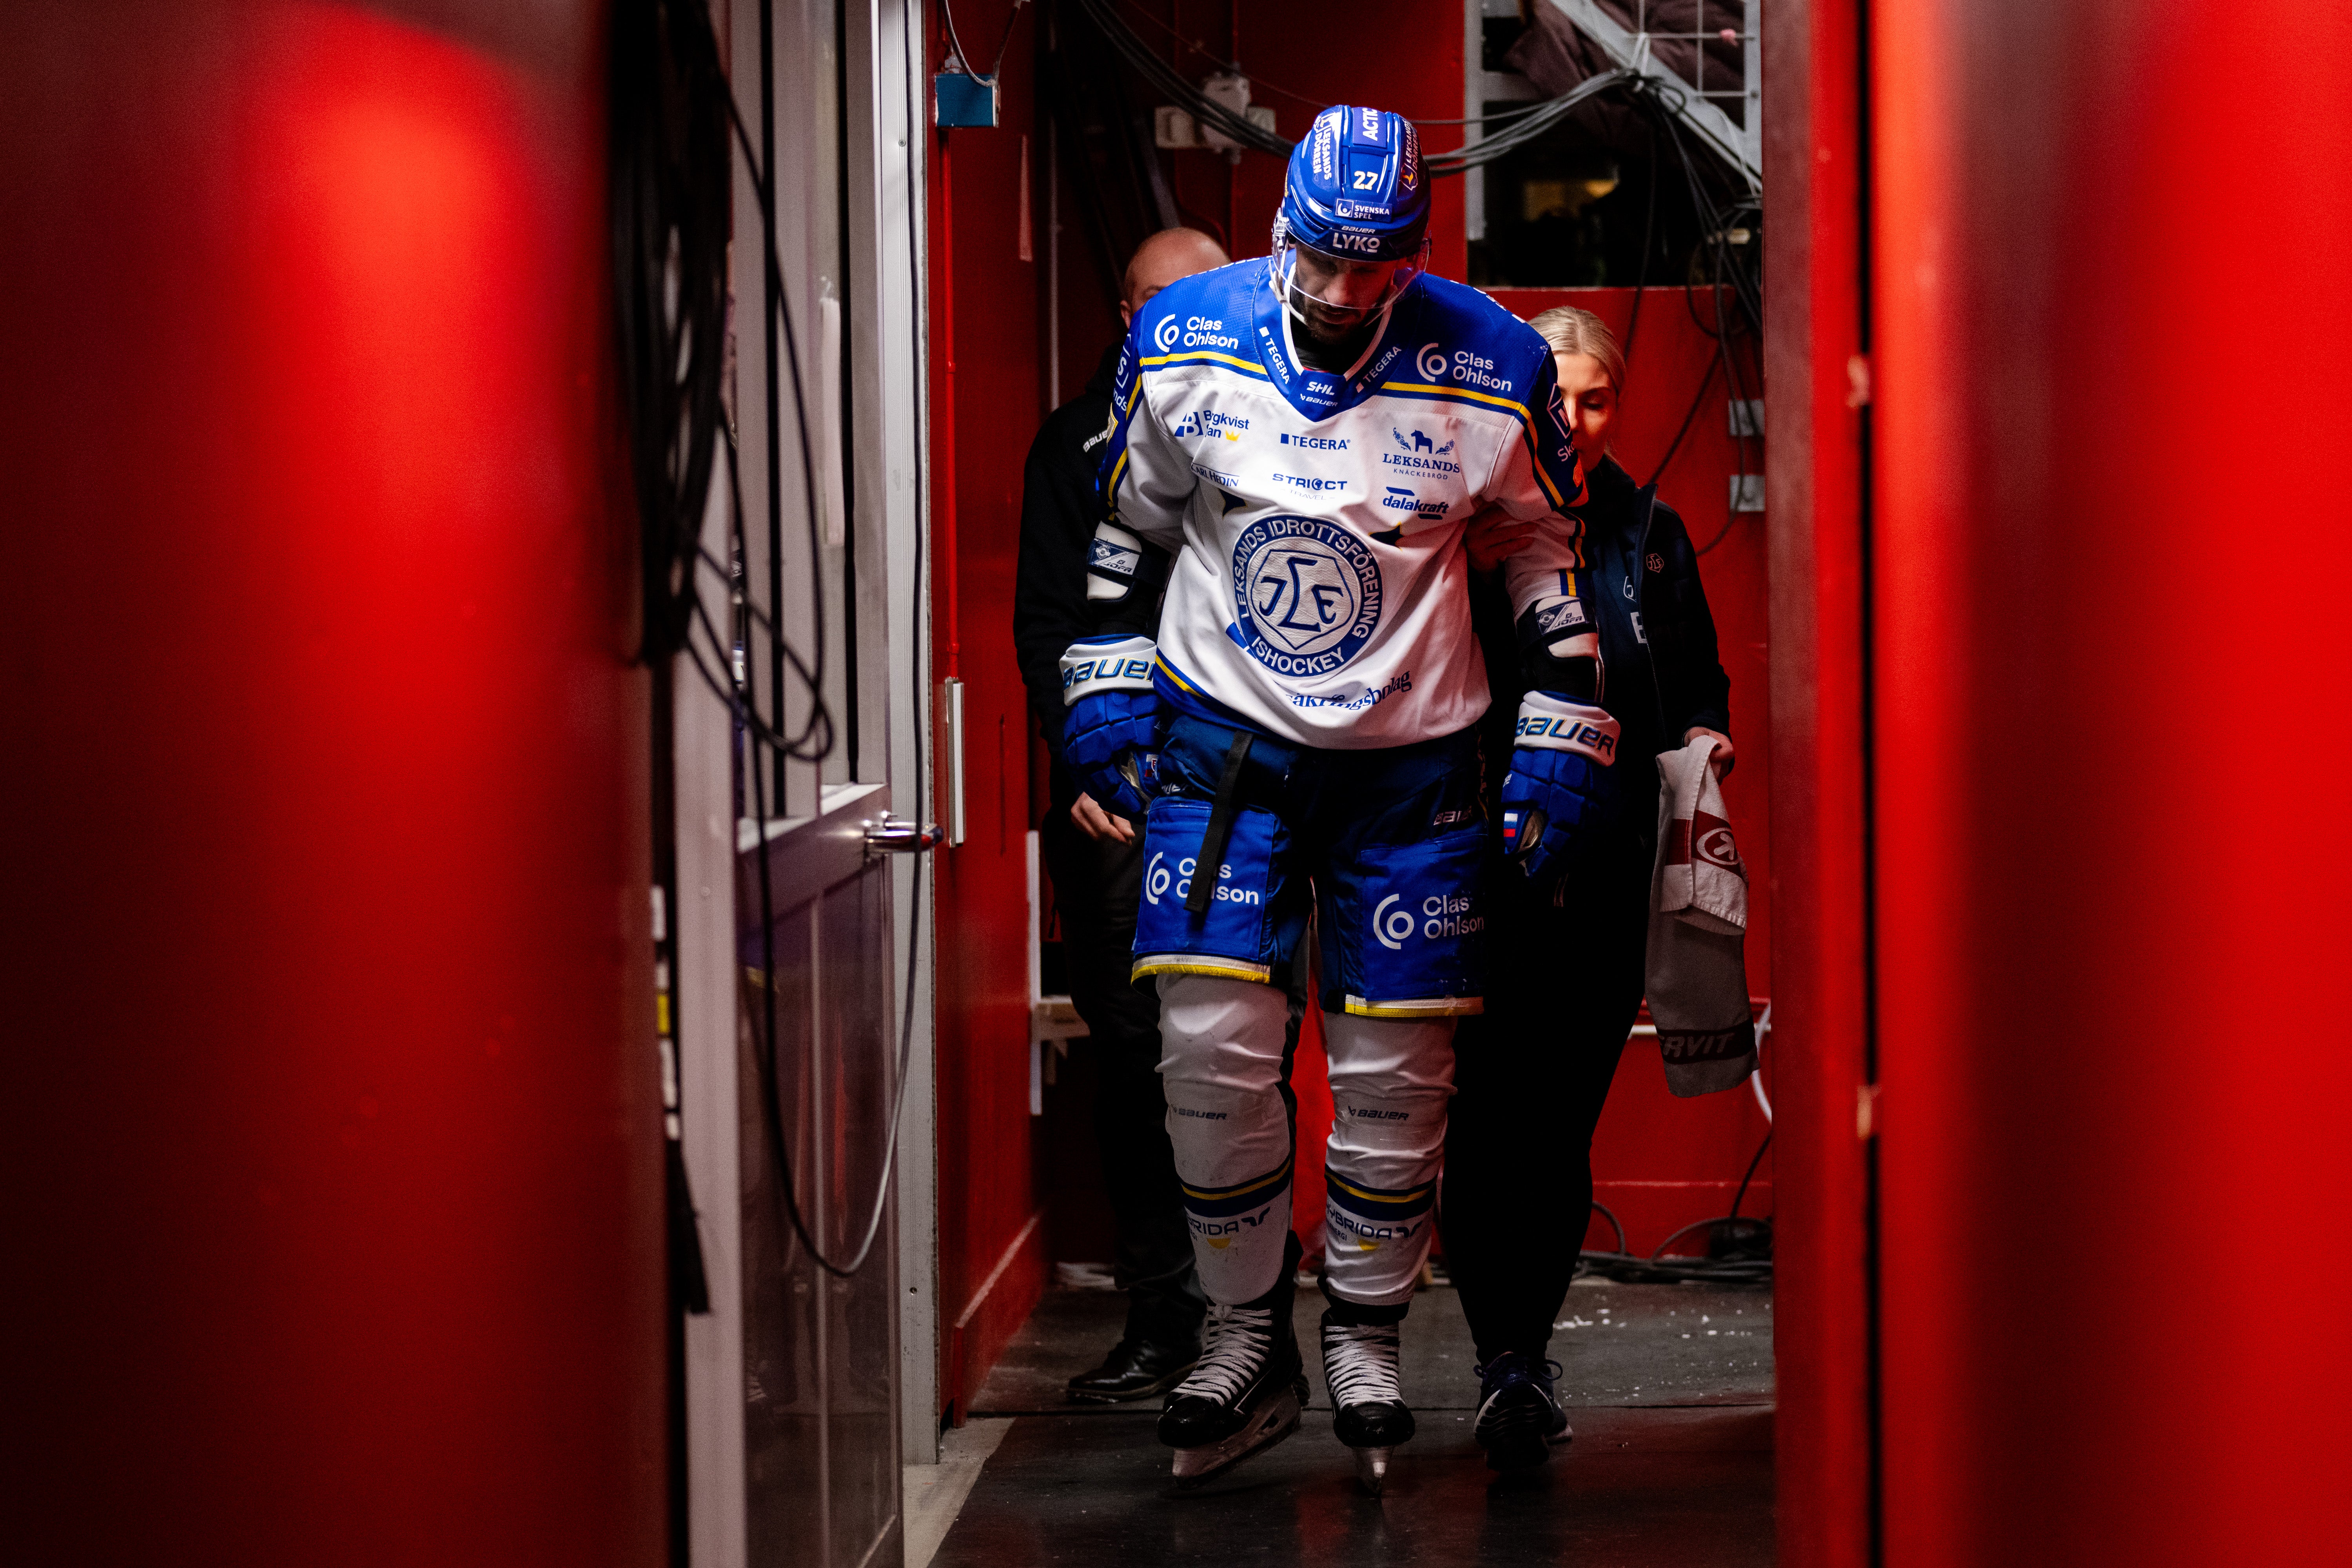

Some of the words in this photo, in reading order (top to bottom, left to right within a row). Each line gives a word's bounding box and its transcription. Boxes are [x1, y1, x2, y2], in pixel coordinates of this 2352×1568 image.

[1402, 119, 1412, 164] LEKSANDS
[1313, 132, 1323, 174] DÖRREN
[1322, 128, 1332, 180] LEKSANDS
[1353, 170, 1378, 191] 27
[1354, 205, 1390, 215] SVENSKA
[1186, 316, 1223, 331] Clas
[1183, 332, 1239, 350] Ohlson
[1265, 338, 1290, 385] TEGERA
[1363, 346, 1402, 383] TEGERA
[1454, 351, 1494, 370] Clas
[1307, 381, 1335, 396] SHL
[1453, 365, 1512, 392] Ohlson
[1082, 430, 1108, 453] BAUE
[1382, 453, 1460, 473] LEKSANDS
[1394, 468, 1448, 480] KNÄCKEBRÖD
[1209, 470, 1239, 487] HEDIN
[1382, 495, 1449, 514] dalakraft
[1103, 562, 1132, 573] JOFA
[1235, 525, 1267, 619] LEKSANDS
[1267, 519, 1380, 639] IDROTTSFÖRENING
[1554, 615, 1582, 628] JOFA
[1251, 635, 1345, 675] ISHOCKEY
[1178, 857, 1232, 879] Cs
[1176, 878, 1259, 905] Olson
[1423, 894, 1470, 917] Clas
[1424, 915, 1485, 939] Ohlson
